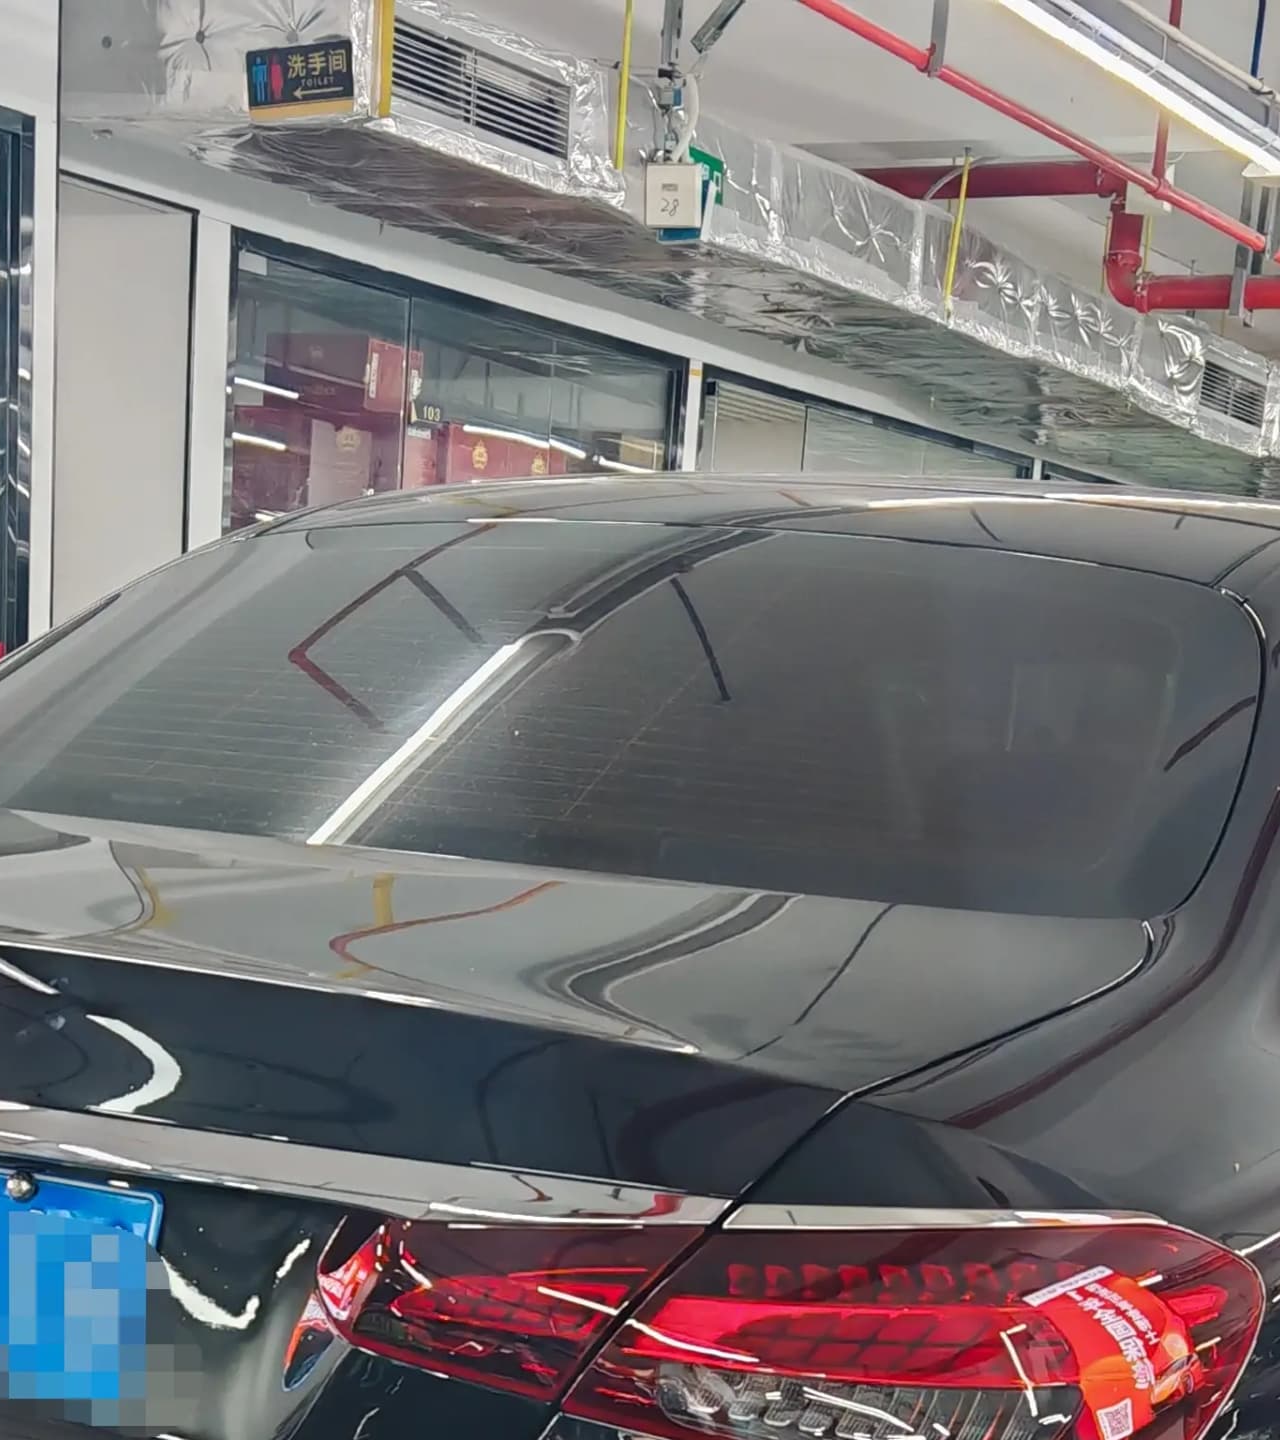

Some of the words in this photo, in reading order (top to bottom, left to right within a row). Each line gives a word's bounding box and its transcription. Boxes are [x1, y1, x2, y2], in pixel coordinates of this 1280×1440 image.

[287, 49, 347, 79] 洗手间
[300, 76, 334, 87] TOILET
[660, 198, 680, 217] 28
[423, 405, 441, 422] 103
